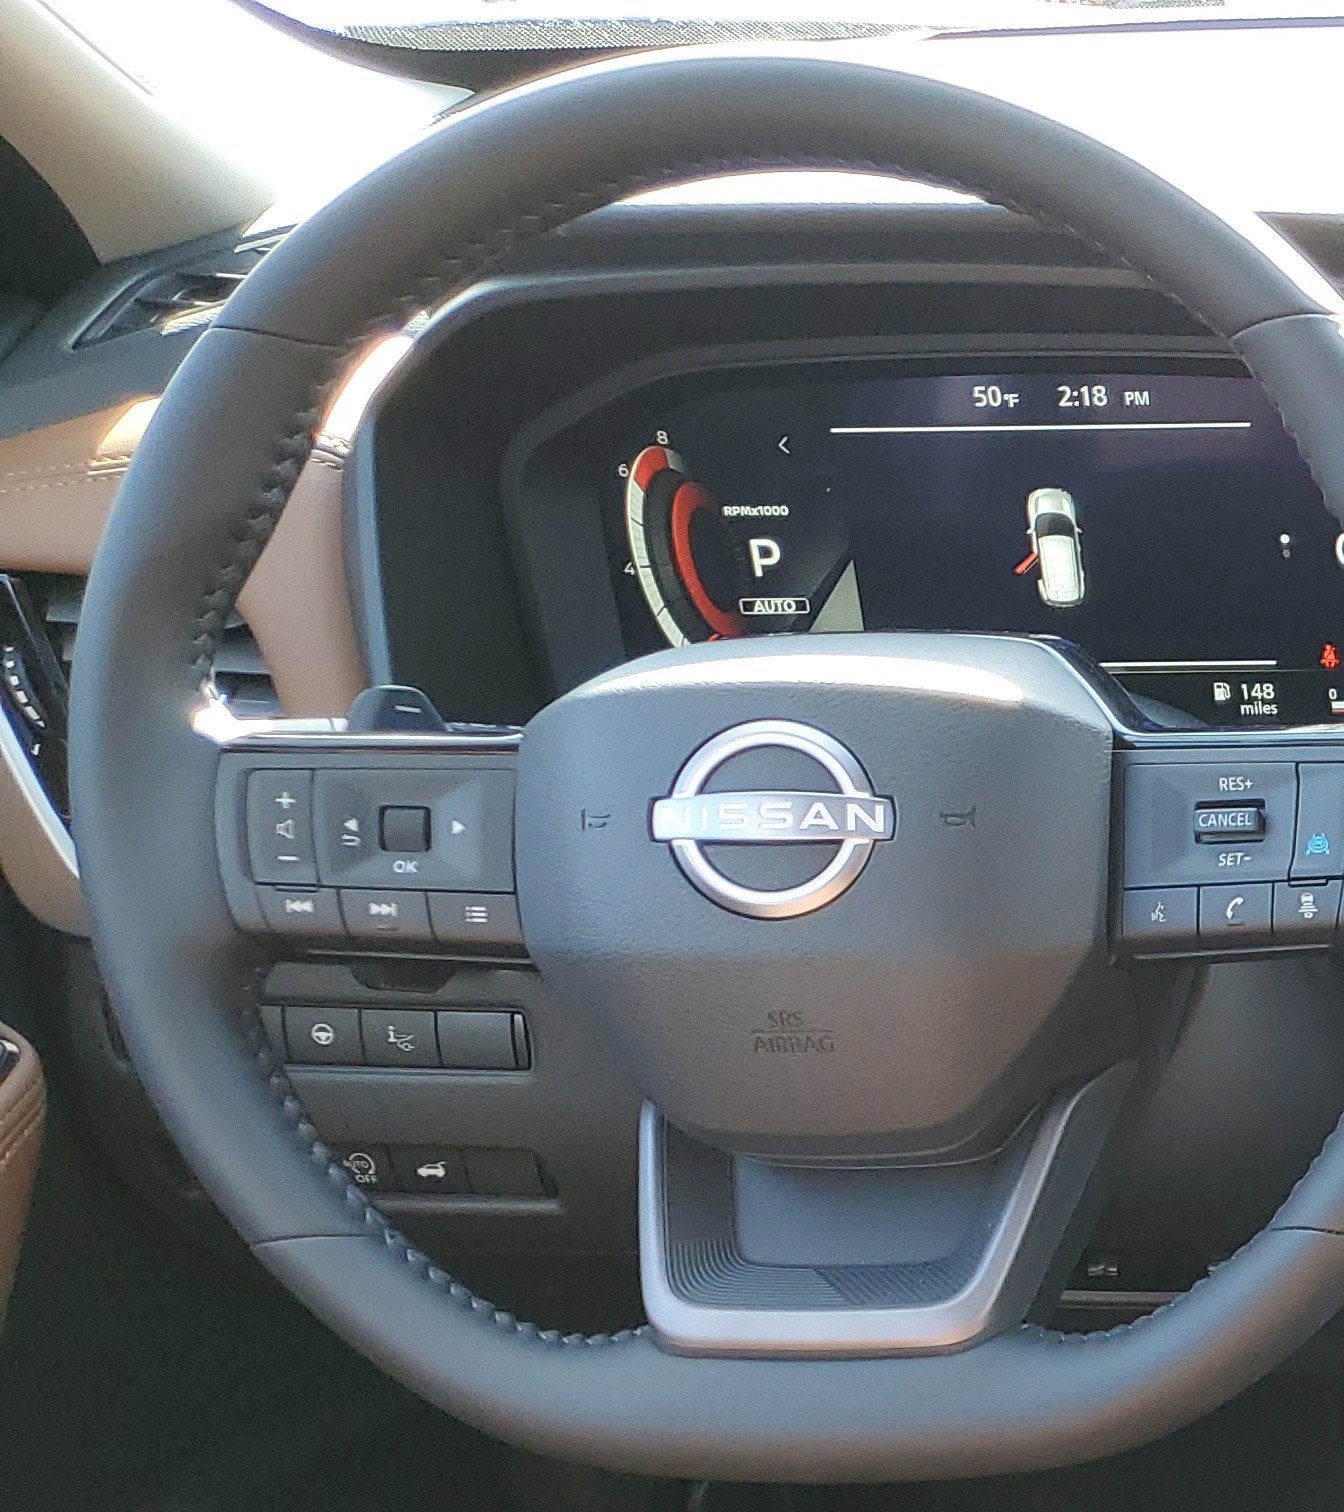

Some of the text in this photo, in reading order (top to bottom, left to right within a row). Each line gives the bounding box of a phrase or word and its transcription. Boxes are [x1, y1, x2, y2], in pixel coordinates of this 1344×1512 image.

[1057, 385, 1151, 407] 2:18 PM
[656, 430, 669, 445] 8
[618, 463, 629, 478] 6
[723, 505, 789, 516] RPMx1000
[749, 538, 781, 577] P
[624, 562, 636, 576] 4
[753, 602, 797, 613] AUTO
[1240, 683, 1275, 700] 148
[1240, 701, 1278, 715] miles
[1219, 777, 1253, 791] RES+
[661, 801, 886, 834] NISSAN
[1198, 812, 1253, 827] CANCEL
[393, 860, 418, 874] OK
